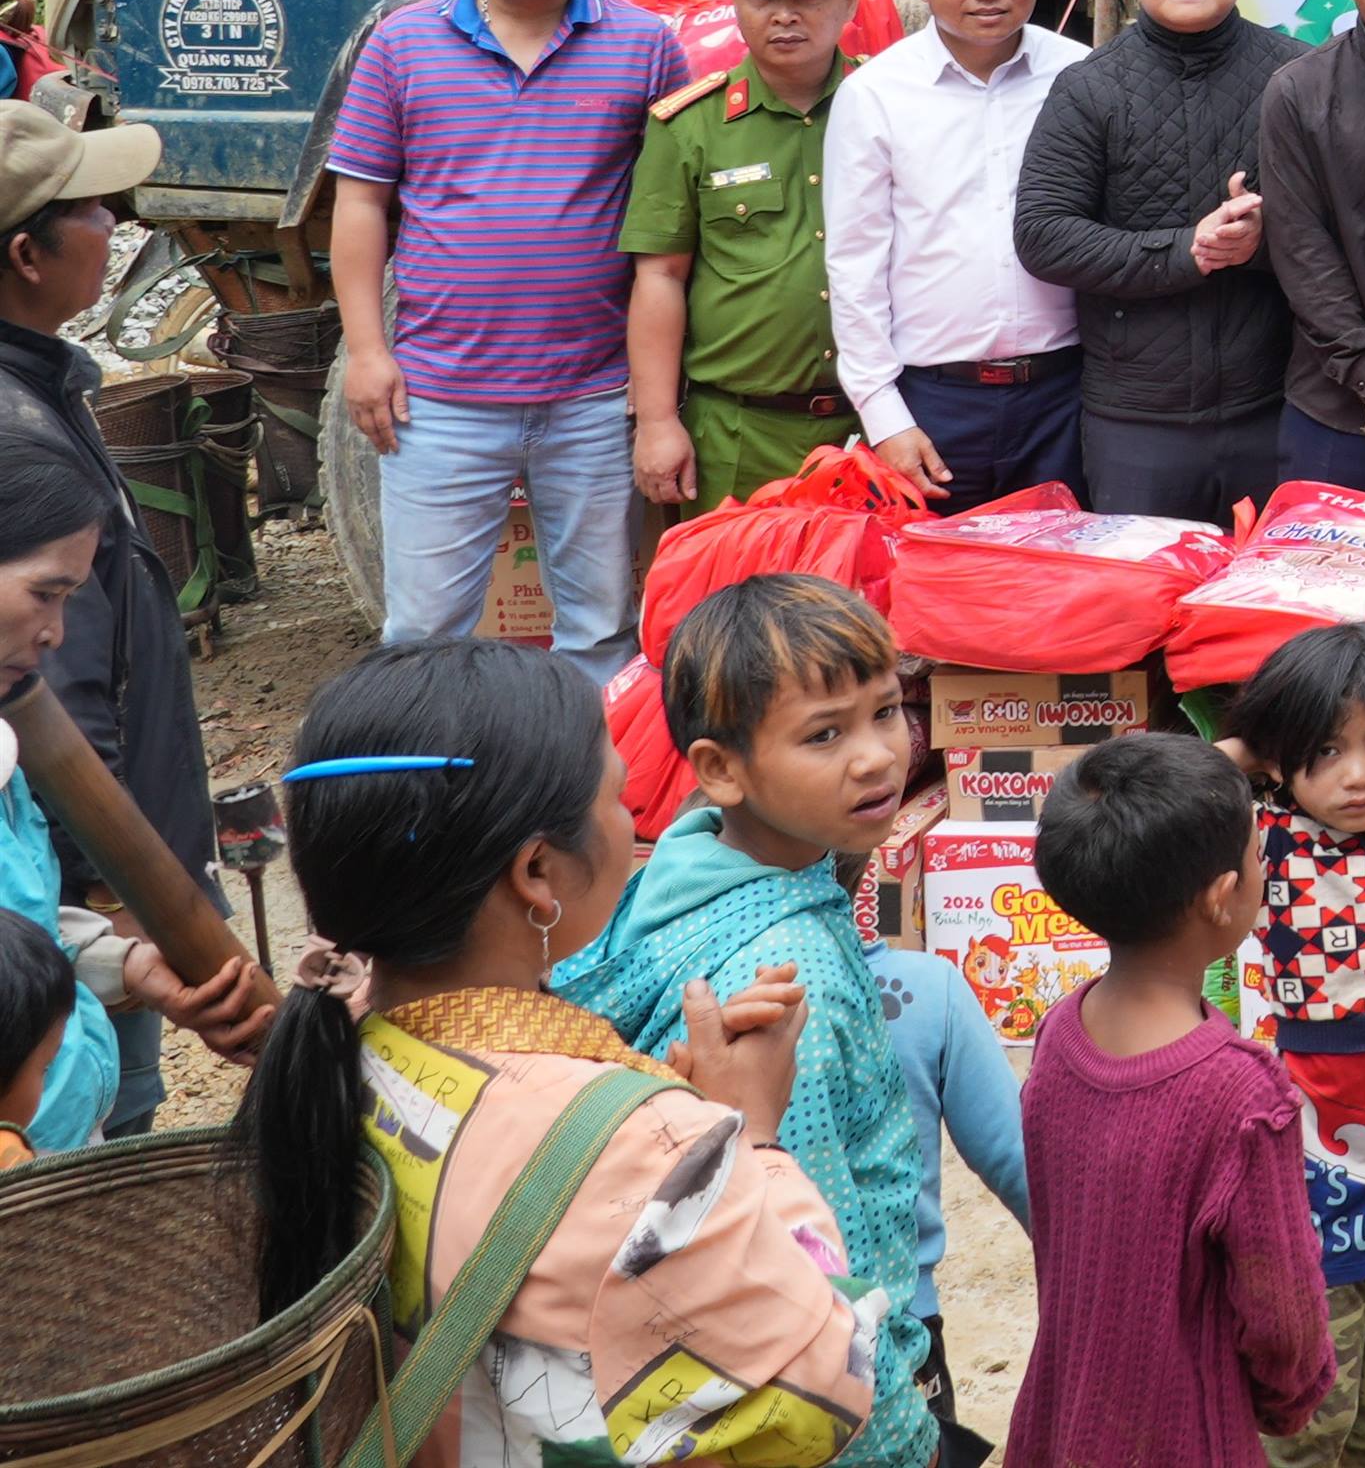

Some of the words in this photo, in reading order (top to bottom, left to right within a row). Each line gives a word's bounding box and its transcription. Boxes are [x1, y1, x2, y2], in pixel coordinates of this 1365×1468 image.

[202, 24, 212, 39] 3
[229, 25, 242, 39] N
[234, 54, 268, 67] NAM
[514, 584, 544, 597] Phú
[982, 698, 1029, 723] 30+3
[1036, 698, 1136, 727] KOKOMI
[943, 896, 984, 909] 2026
